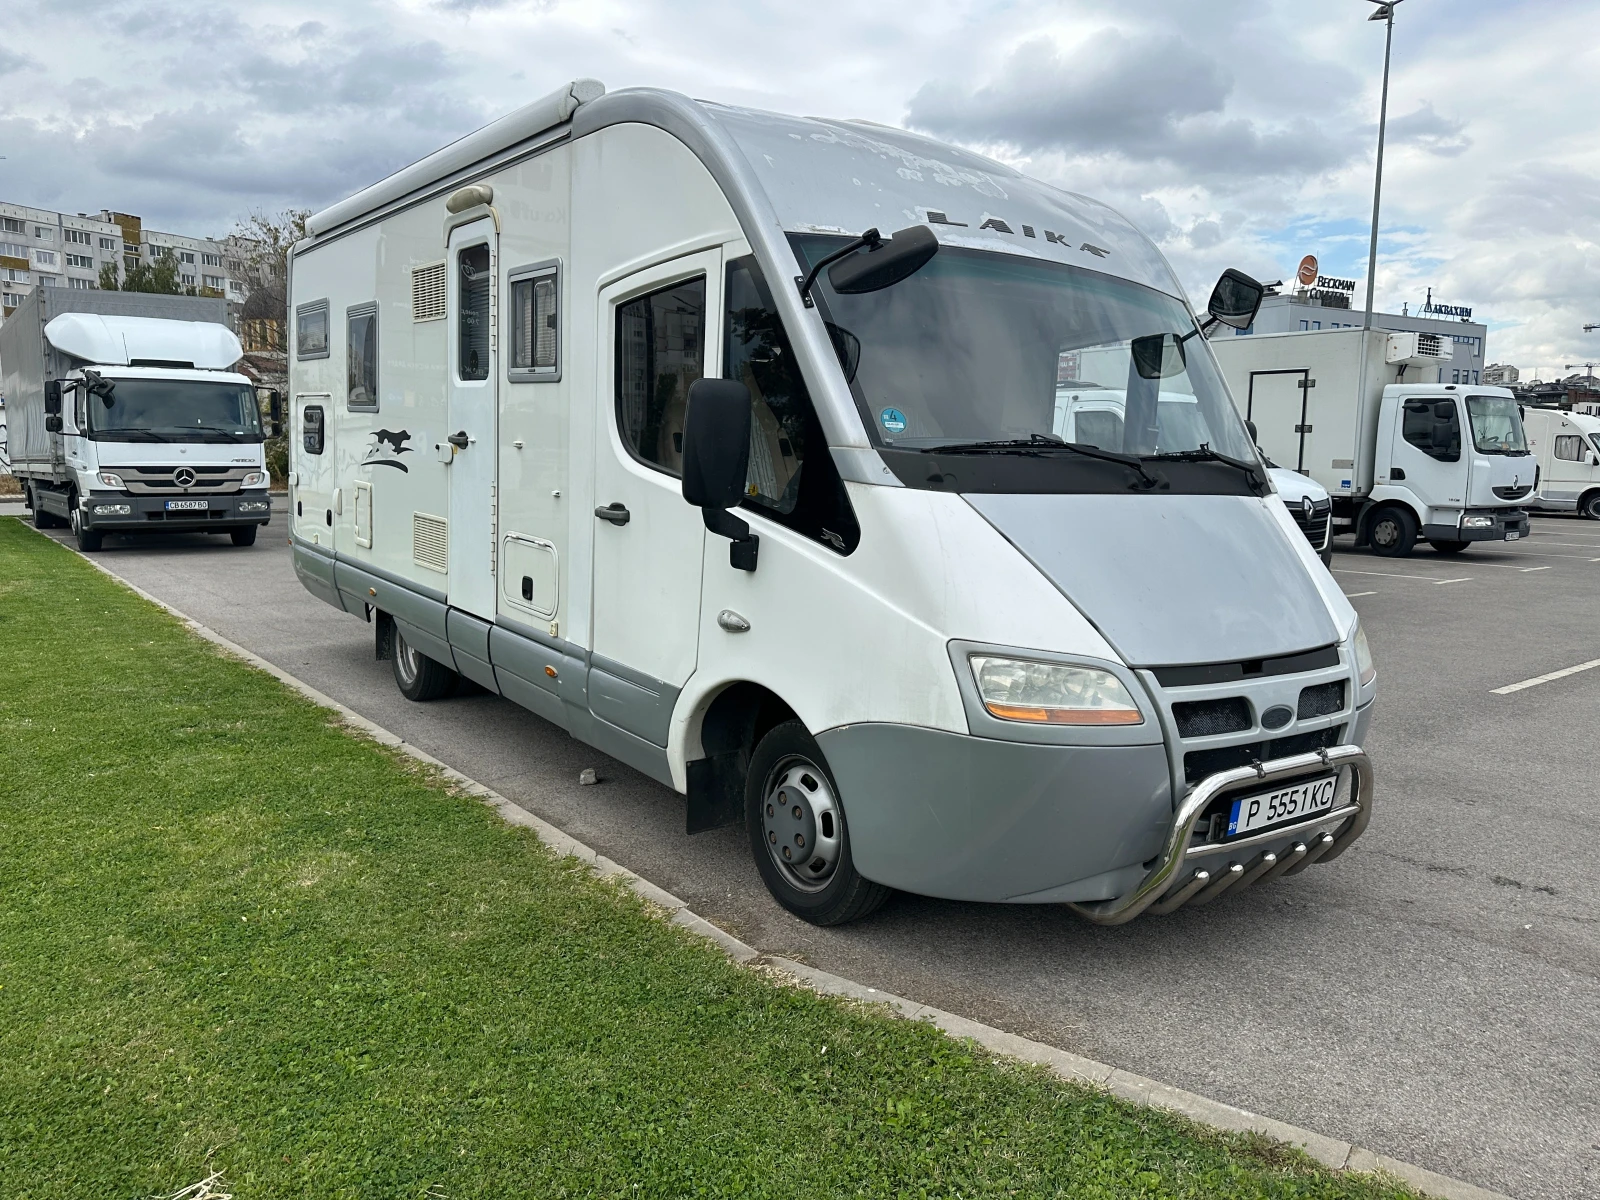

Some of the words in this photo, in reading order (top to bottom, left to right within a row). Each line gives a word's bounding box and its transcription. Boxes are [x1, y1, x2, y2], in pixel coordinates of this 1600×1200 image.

[926, 210, 1111, 259] LAIKA
[1317, 275, 1356, 291] BECKMAN
[889, 409, 898, 422] 4
[1245, 799, 1261, 828] P
[1228, 821, 1238, 831] BG
